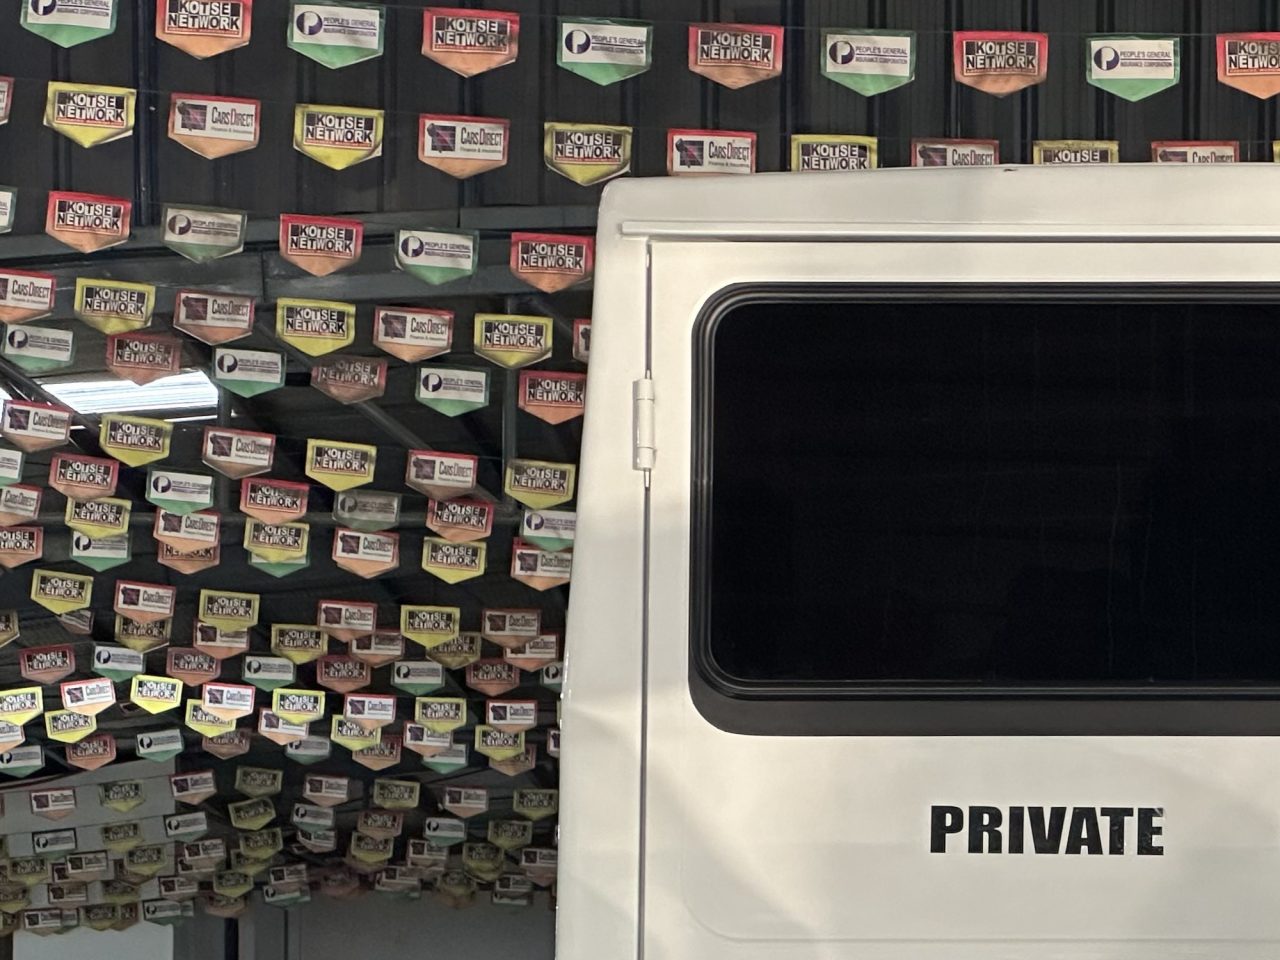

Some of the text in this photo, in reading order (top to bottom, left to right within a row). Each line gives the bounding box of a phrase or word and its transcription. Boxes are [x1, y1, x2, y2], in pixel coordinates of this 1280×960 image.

[179, 0, 230, 15] KOTSE
[168, 14, 240, 29] NETWORK
[445, 19, 498, 33] KOTSE
[435, 32, 506, 47] NETWORK
[711, 31, 761, 46] KOTSE
[700, 46, 770, 61] NETWORK
[976, 41, 1026, 54] KOTSE
[966, 55, 1035, 68] NETWORK
[68, 93, 115, 108] KOTSE
[57, 106, 124, 121] NETWORK
[316, 116, 366, 130] KOTSE
[305, 127, 373, 144] NETWORK
[565, 133, 611, 145] KOTSE
[556, 145, 621, 158] NETWORK
[811, 144, 858, 157] KOTSE
[1051, 150, 1099, 162] KOTSE
[802, 157, 866, 170] NETWORK
[67, 202, 113, 216] KOTSE
[57, 215, 119, 229] NETWORK
[300, 225, 345, 240] KOTSE
[291, 236, 352, 252] NETWORK
[530, 243, 574, 256] KOTSE
[521, 255, 582, 268] NETWORK
[94, 288, 137, 302] KOTSE
[85, 300, 143, 314] NETWORK
[295, 306, 337, 320] KOTSE
[287, 318, 345, 332] NETWORK
[493, 324, 534, 335] KOTSE
[484, 334, 542, 347] NETWORK
[930, 805, 1165, 856] PRIVATE
